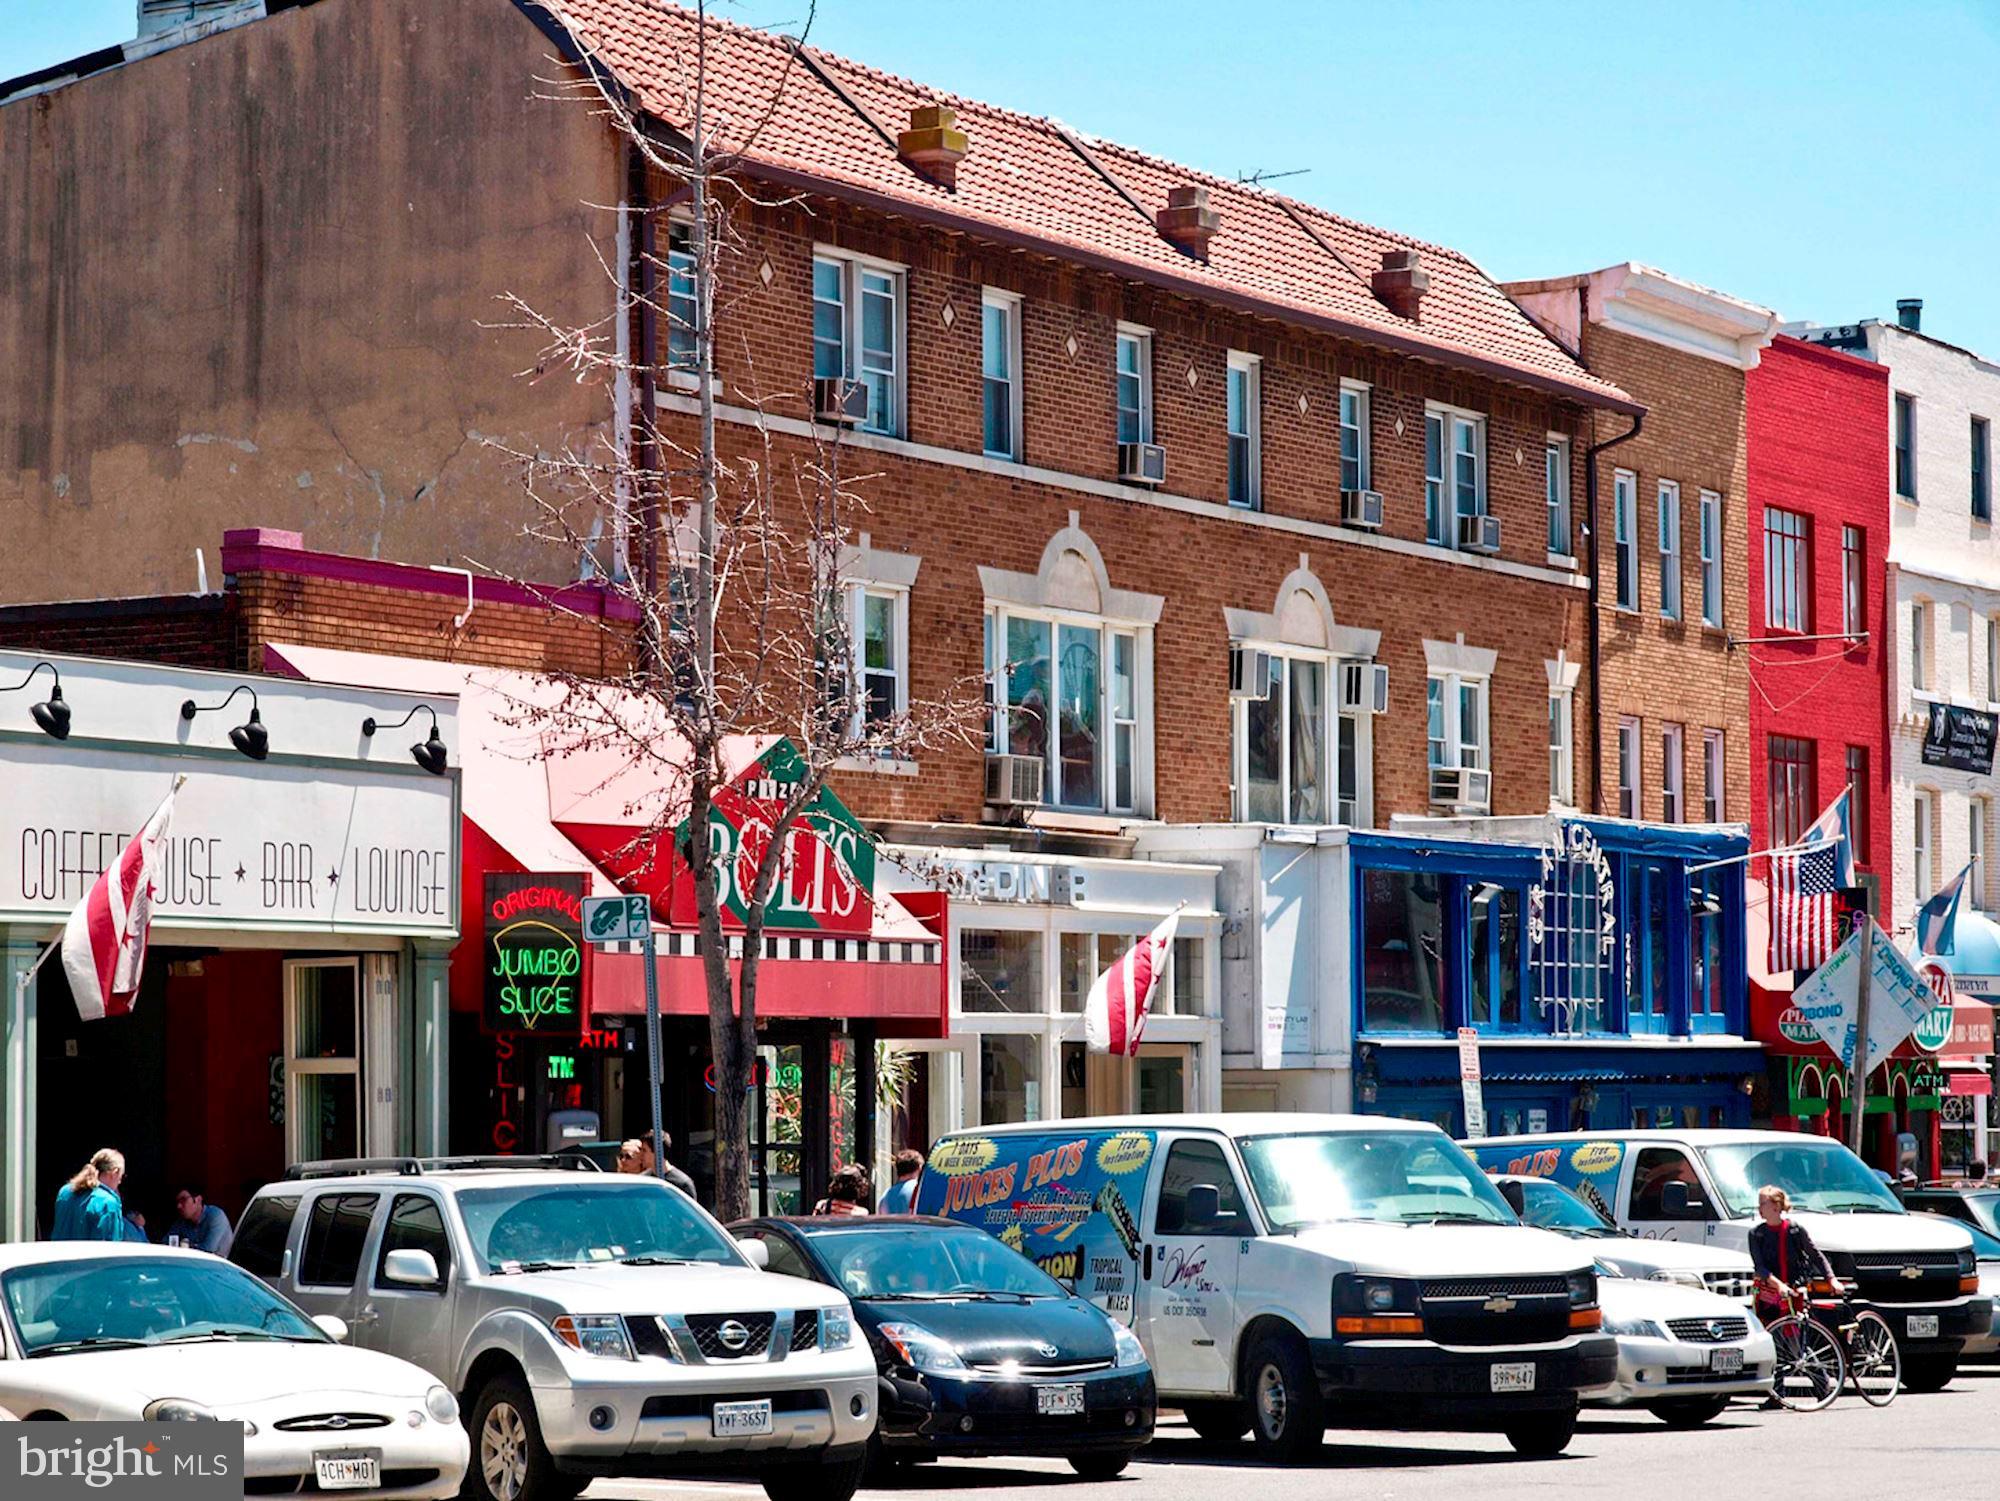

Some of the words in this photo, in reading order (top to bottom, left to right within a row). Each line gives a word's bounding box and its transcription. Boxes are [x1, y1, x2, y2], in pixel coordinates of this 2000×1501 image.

[710, 819, 857, 917] BOLI'S
[261, 841, 315, 909] BAR
[354, 846, 446, 915] LOUNGE
[492, 887, 583, 923] ORIGINAL
[631, 898, 645, 915] 2
[492, 948, 581, 977] JUMBO
[499, 986, 573, 1015] SLICE
[579, 1030, 618, 1048] ATM
[1785, 1025, 1819, 1039] MAR
[1913, 1075, 1944, 1087] ATM
[493, 1033, 518, 1155] SLIC
[1116, 1138, 1138, 1151] Free
[1590, 1146, 1609, 1155] Free
[939, 1162, 1018, 1217] JUICES
[1022, 1140, 1088, 1191] PLUS
[1090, 1258, 1123, 1274] TROPICAL
[1107, 1295, 1130, 1311] MIXES
